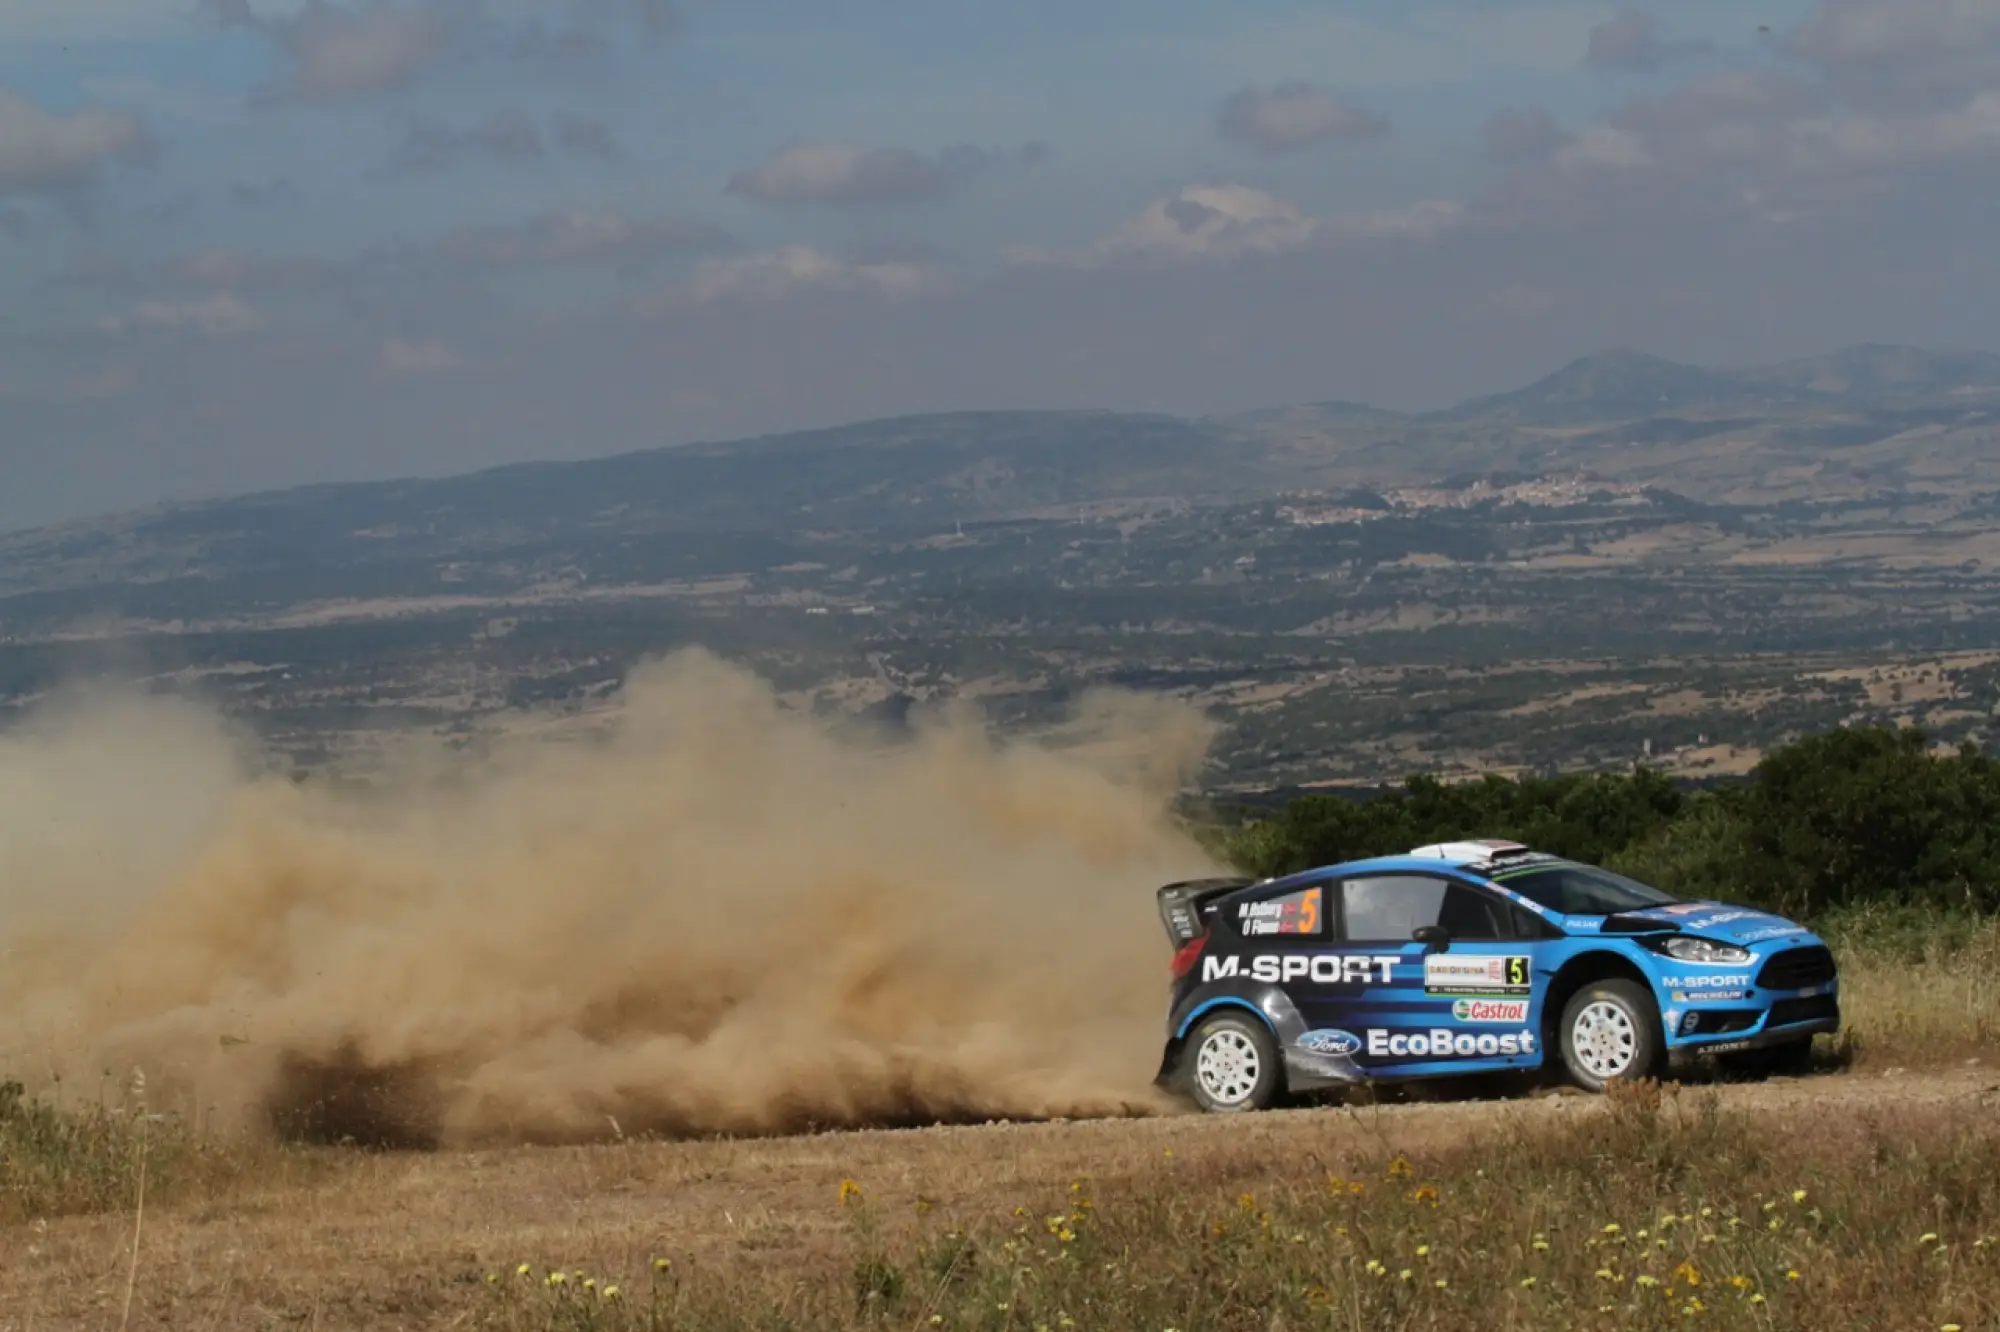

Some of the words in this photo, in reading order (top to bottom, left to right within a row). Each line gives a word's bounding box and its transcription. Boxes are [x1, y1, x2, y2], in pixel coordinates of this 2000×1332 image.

[1298, 888, 1320, 934] 5
[1202, 955, 1401, 983] M-SPORT
[1510, 957, 1523, 985] 5
[1662, 975, 1750, 987] M-SPORT
[1471, 1001, 1524, 1019] Castrol
[1307, 1033, 1352, 1052] Ford
[1366, 1028, 1536, 1056] EcoBoost
